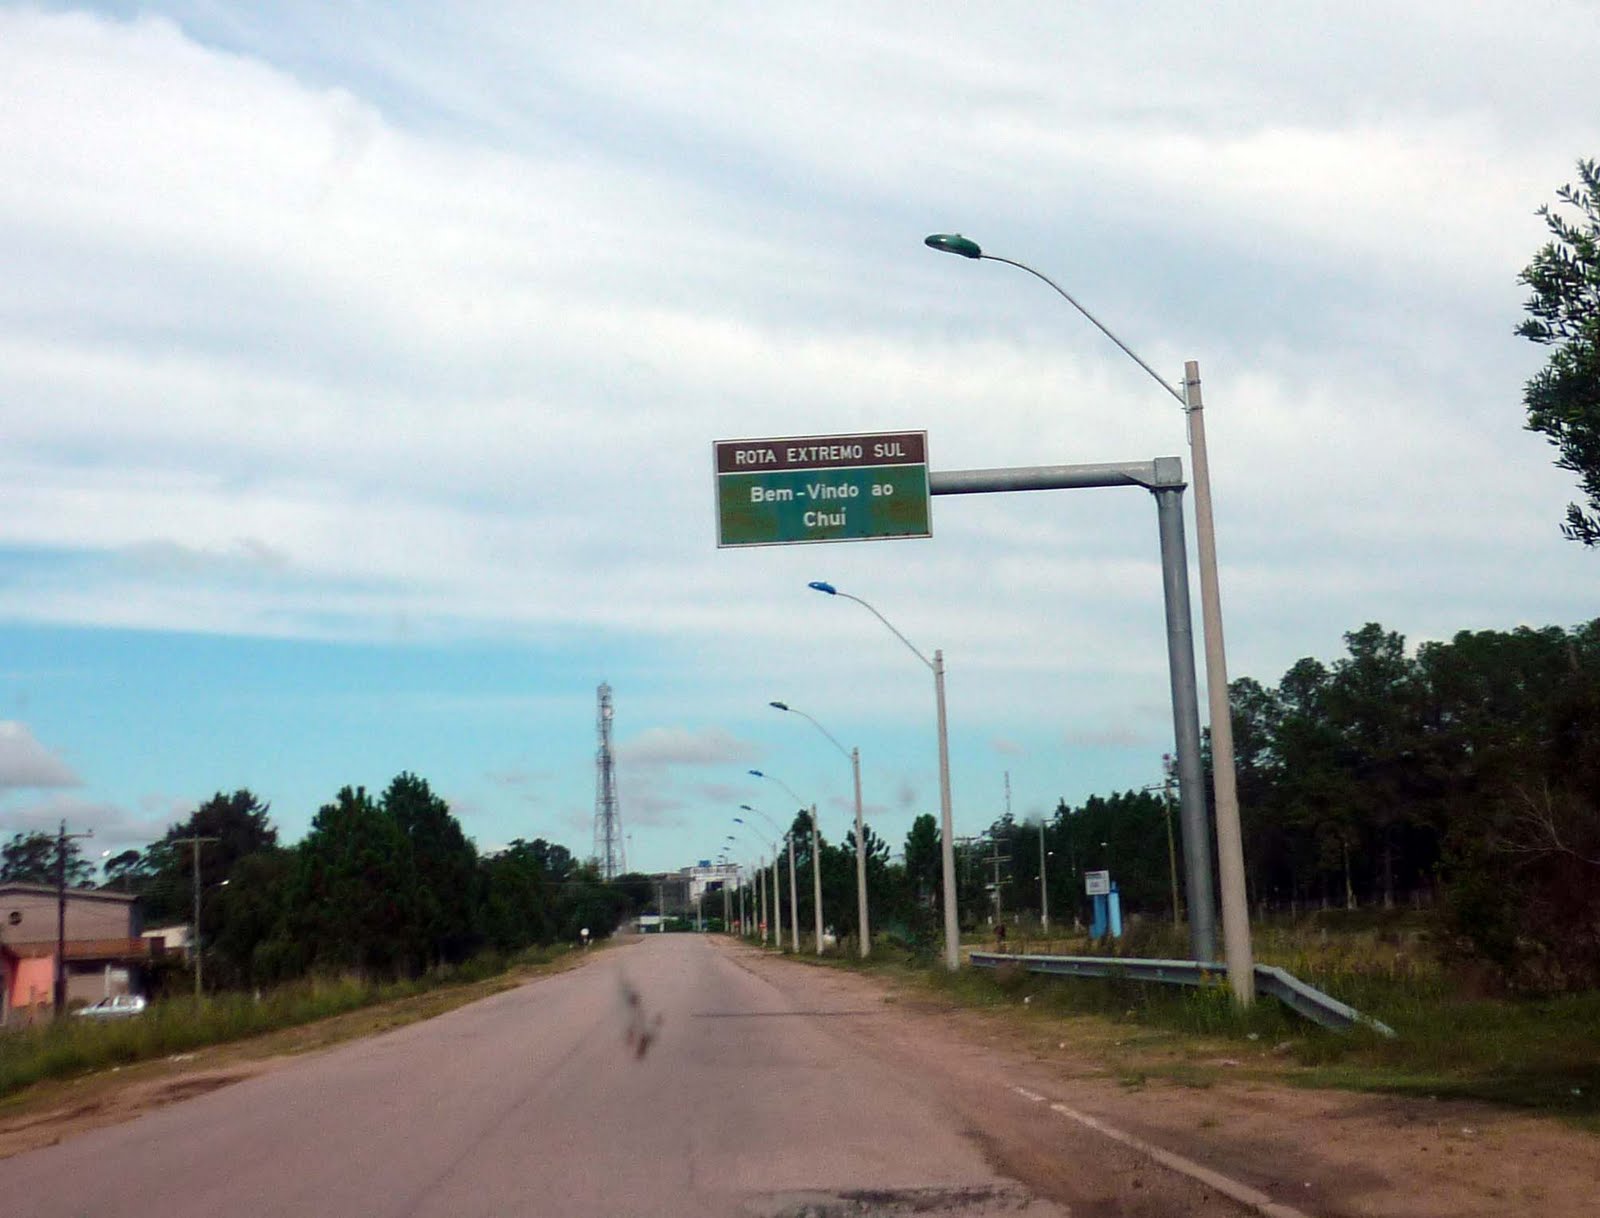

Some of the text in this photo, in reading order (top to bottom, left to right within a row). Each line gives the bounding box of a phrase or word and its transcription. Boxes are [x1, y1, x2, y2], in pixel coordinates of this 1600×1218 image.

[735, 442, 906, 465] ROTA EXTREMO SUL
[871, 483, 894, 496] ao
[802, 506, 847, 528] Chuí
